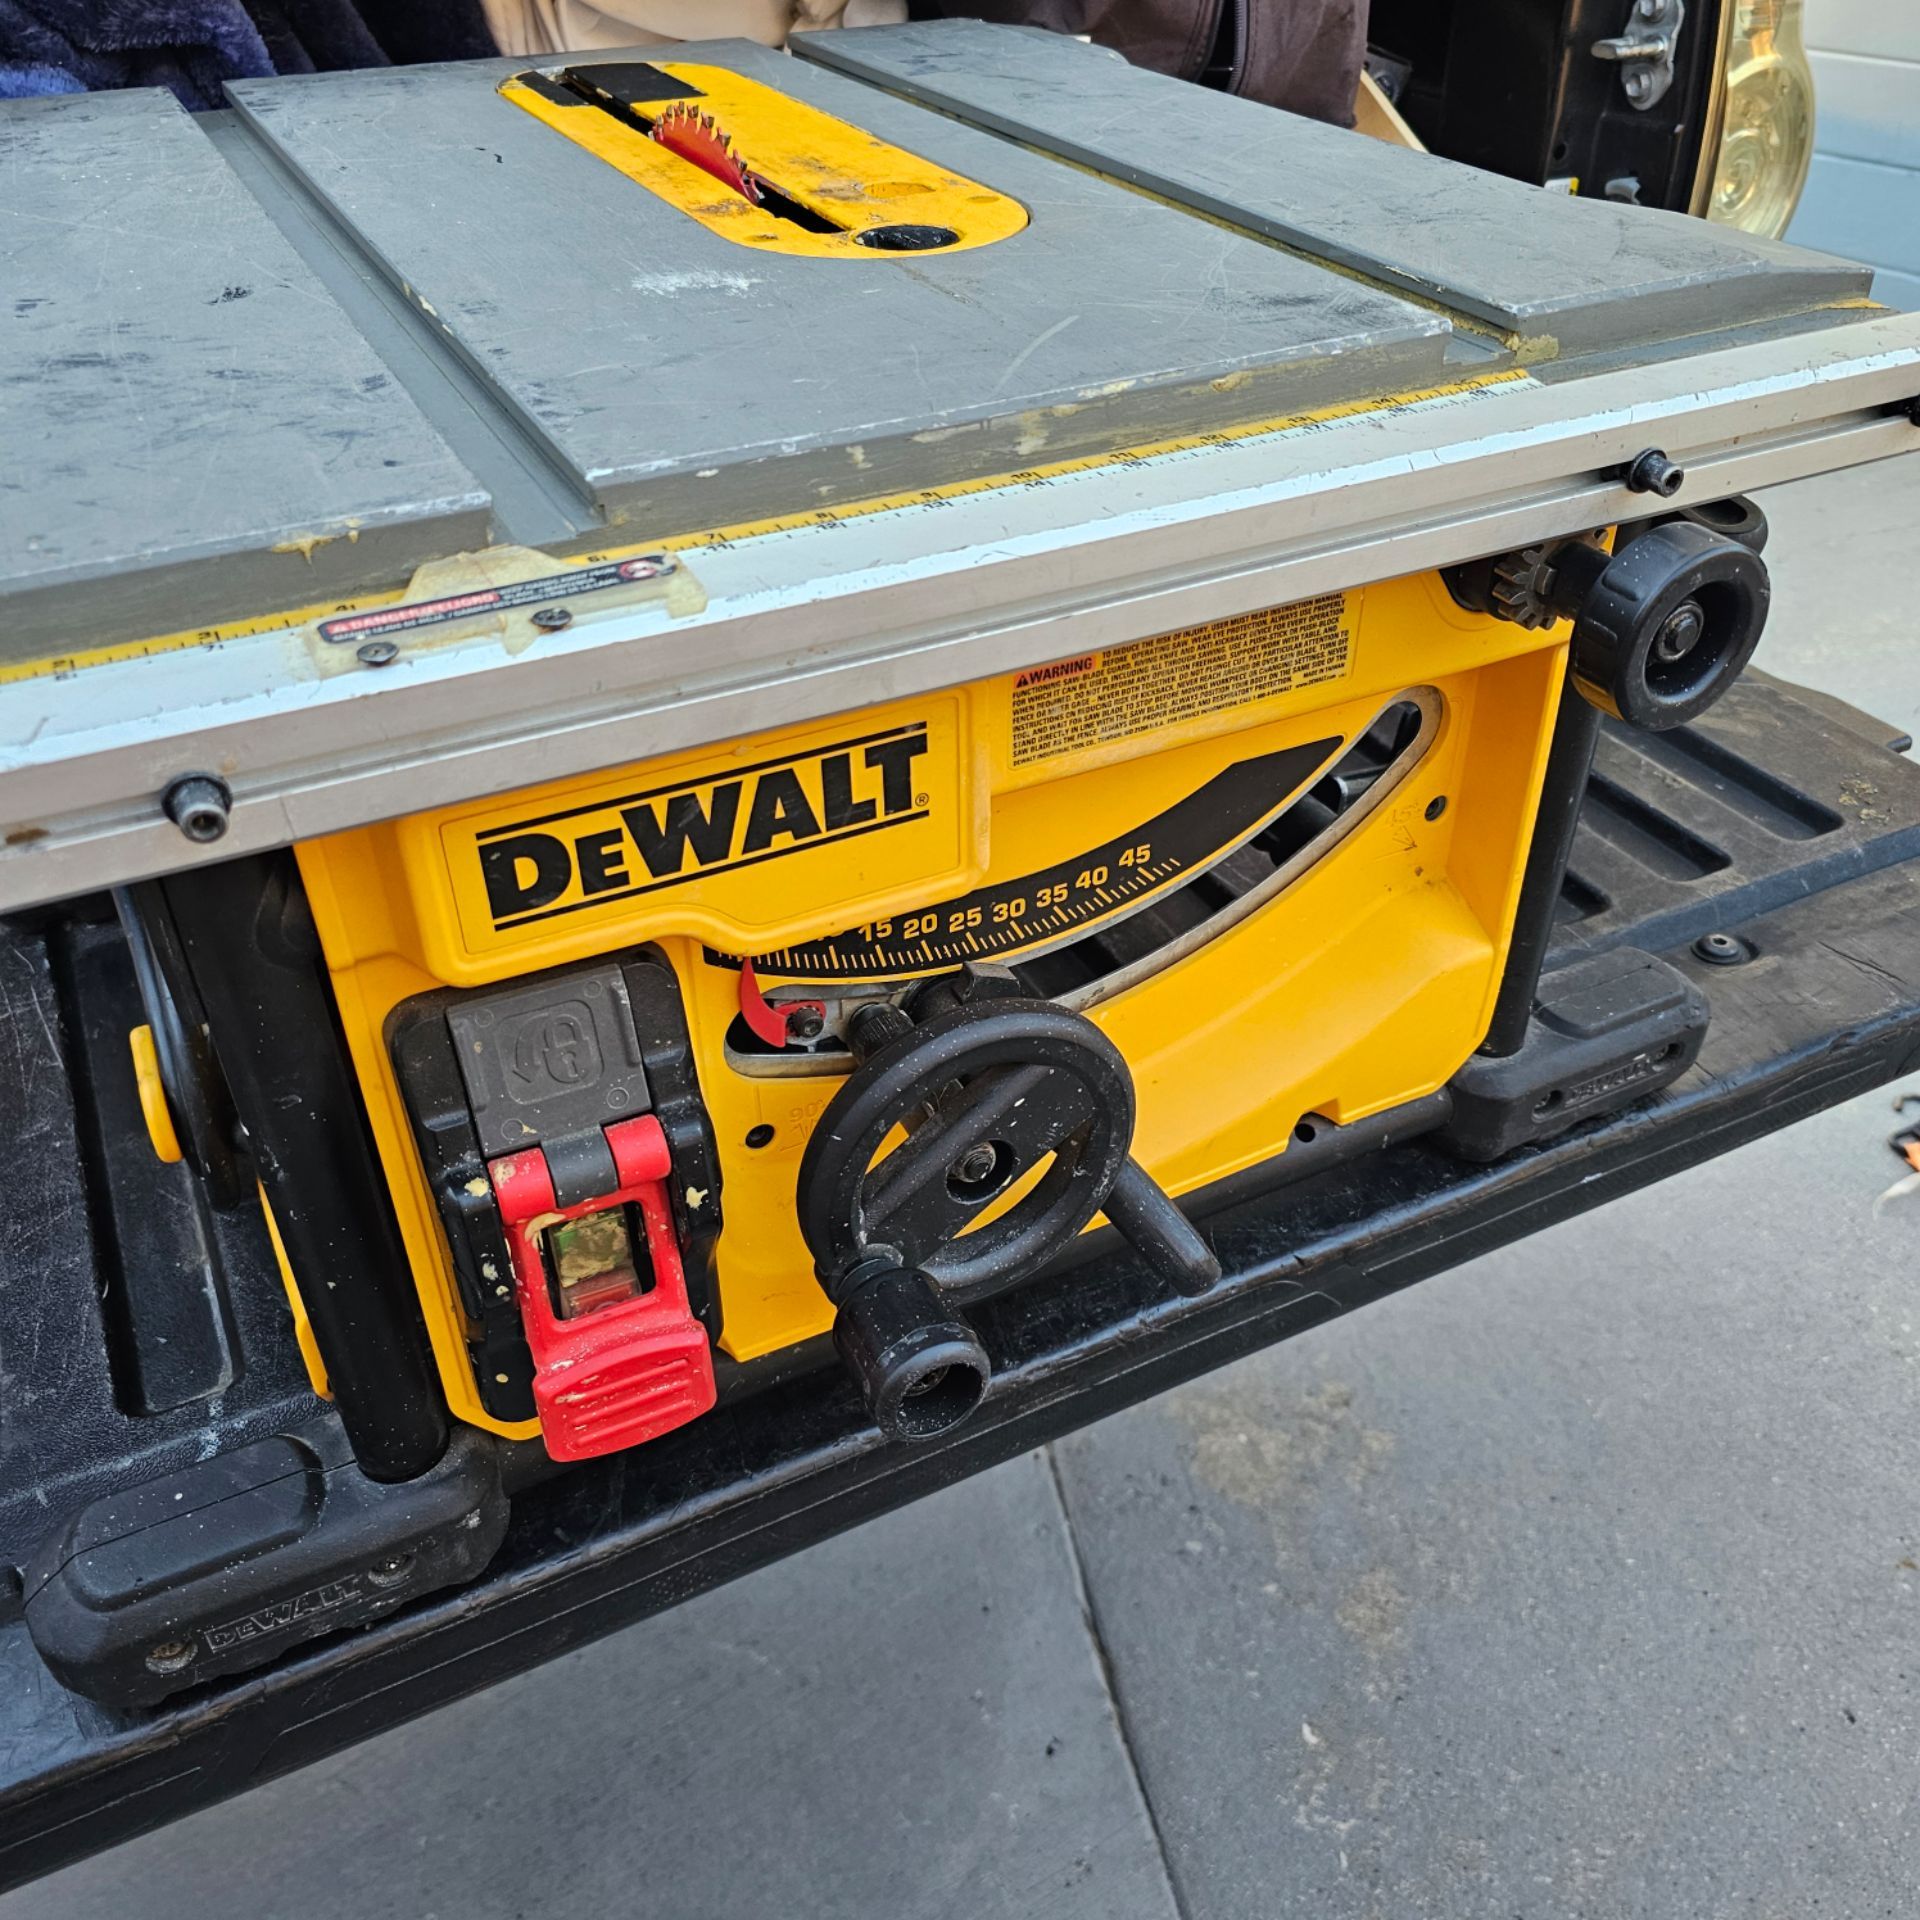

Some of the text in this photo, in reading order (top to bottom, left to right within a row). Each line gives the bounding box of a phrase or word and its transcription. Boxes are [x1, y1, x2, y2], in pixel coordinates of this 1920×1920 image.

[1012, 680, 1060, 698] FUNCTIONING
[1180, 646, 1194, 654] AND
[1273, 623, 1285, 631] FOR
[1287, 617, 1306, 627] EVERY
[1308, 607, 1344, 621] OPERATION
[1012, 704, 1034, 715] WHEN
[1102, 678, 1134, 691] PERFORM
[1136, 674, 1149, 682] ANY
[1230, 645, 1258, 658] SUPPORT
[1261, 640, 1279, 649] WORK
[1282, 635, 1299, 644] WITH
[1323, 625, 1337, 633] AND
[1029, 657, 1093, 685] WARNING
[1102, 599, 1345, 666] BEFORE OPERATING WEAR EYE ALWAYS USE PROPERLY
[1102, 650, 1110, 658] TO
[1113, 643, 1138, 655] REDUCE
[1142, 639, 1153, 648] THE
[1156, 635, 1170, 644] RISK
[1173, 632, 1181, 640] OF
[1211, 620, 1228, 630] USER
[1230, 615, 1248, 625] MUST
[1251, 610, 1268, 620] READ
[1012, 698, 1025, 706] FOR
[1028, 691, 1051, 702] WHICH
[1062, 684, 1076, 694] CAN
[1111, 666, 1148, 681] INCLUDING
[1151, 662, 1161, 670] ALL
[1164, 654, 1195, 667] THROUGH
[1229, 642, 1240, 650] USE
[1012, 713, 1033, 724] FENCE
[1097, 690, 1119, 701] NEVER
[1121, 685, 1139, 695] BOTH
[1190, 668, 1203, 676] NOT
[1205, 661, 1230, 672] PLUNGE
[1248, 653, 1260, 661] PAY
[1262, 642, 1302, 657] PARTICULAR
[1303, 632, 1338, 646] ATTENTION
[1012, 713, 1063, 732] INSTRUCTIONS
[1065, 710, 1075, 718] ON
[1177, 677, 1197, 688] NEVER
[1199, 671, 1220, 682] REACH
[1013, 737, 1035, 748] STAND
[1130, 708, 1144, 717] SAW
[1171, 693, 1197, 706] ALWAYS
[1280, 668, 1290, 676] THE
[1336, 653, 1347, 661] THE
[1032, 726, 1047, 735] AND
[1069, 716, 1081, 725] FOR
[1084, 712, 1099, 721] SAW
[1102, 705, 1122, 716] BLADE
[1126, 702, 1133, 710] TO
[1136, 697, 1152, 707] STOP
[1154, 690, 1178, 702] BEFORE
[1181, 683, 1207, 695] MOVING
[1210, 672, 1246, 687] WORKPIECE
[1327, 645, 1347, 655] NEVER
[1012, 747, 1027, 757] SAW
[1030, 741, 1050, 752] BLADE
[1063, 735, 1074, 743] THE
[1128, 717, 1140, 725] USE
[1198, 698, 1210, 706] AND
[478, 733, 928, 921] DEWALT
[858, 844, 1151, 943] 15 20 25 30 35 40 45
[204, 1576, 362, 1651] DEWALT
